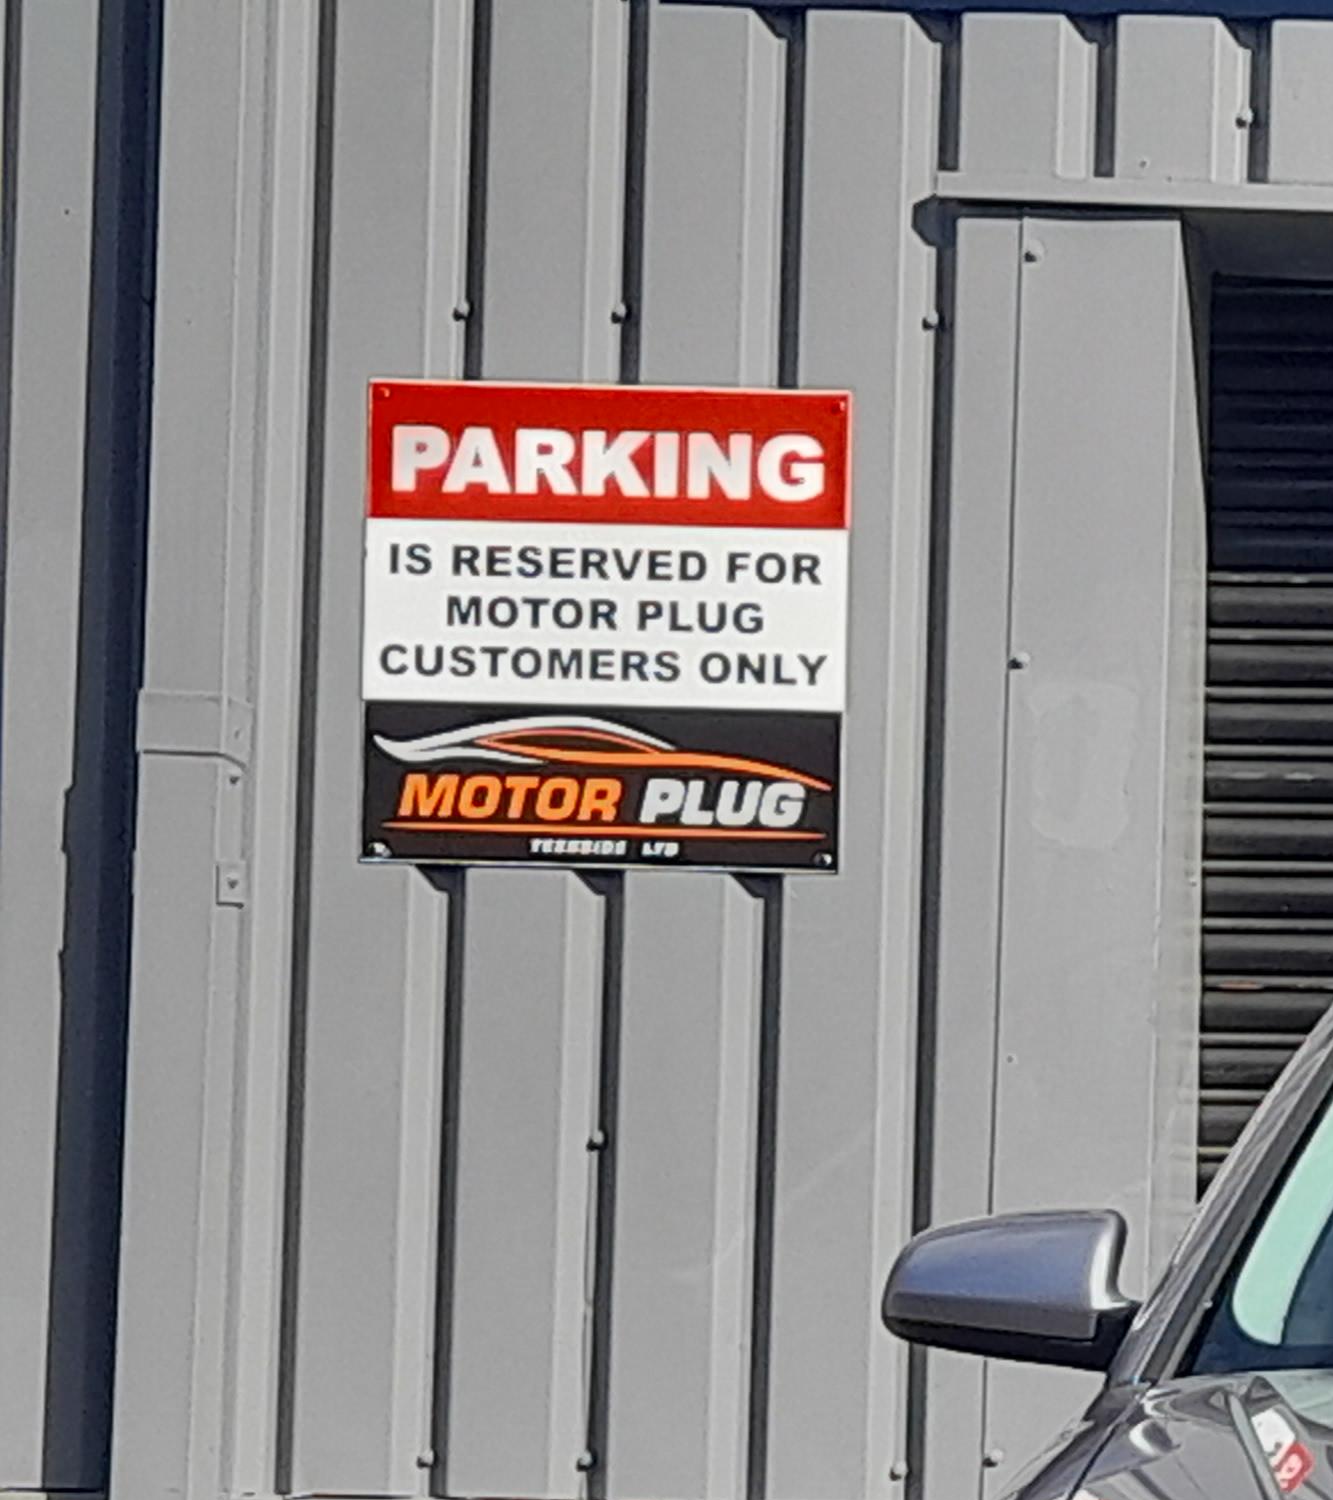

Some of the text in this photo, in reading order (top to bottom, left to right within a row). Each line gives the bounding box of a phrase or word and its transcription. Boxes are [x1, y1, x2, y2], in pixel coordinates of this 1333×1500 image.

[391, 424, 825, 502] PARKING
[389, 543, 822, 585] IS RESERVED FOR
[446, 596, 764, 634] MOTOR PLUG
[379, 644, 828, 686] CUSTOMERS ONLY
[399, 773, 806, 827] MOTOR PLUG
